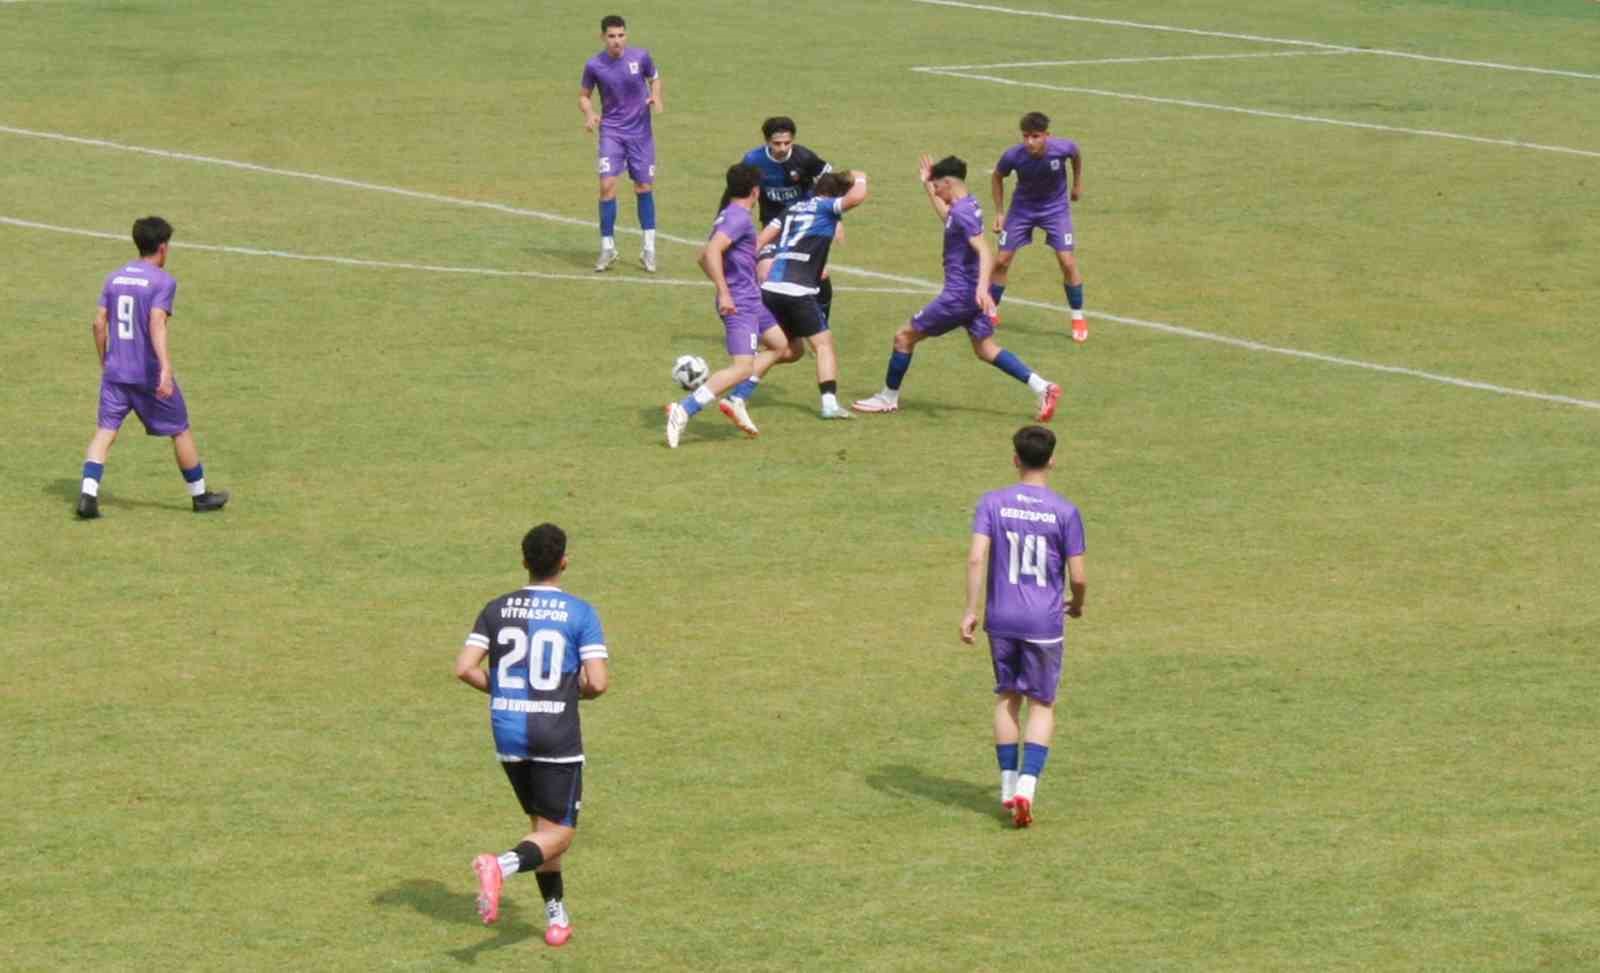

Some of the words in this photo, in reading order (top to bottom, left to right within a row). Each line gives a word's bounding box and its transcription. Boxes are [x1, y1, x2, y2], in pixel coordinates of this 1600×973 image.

[780, 214, 816, 248] 17
[117, 295, 134, 340] 9
[1006, 530, 1047, 588] 14
[497, 626, 567, 691] 20
